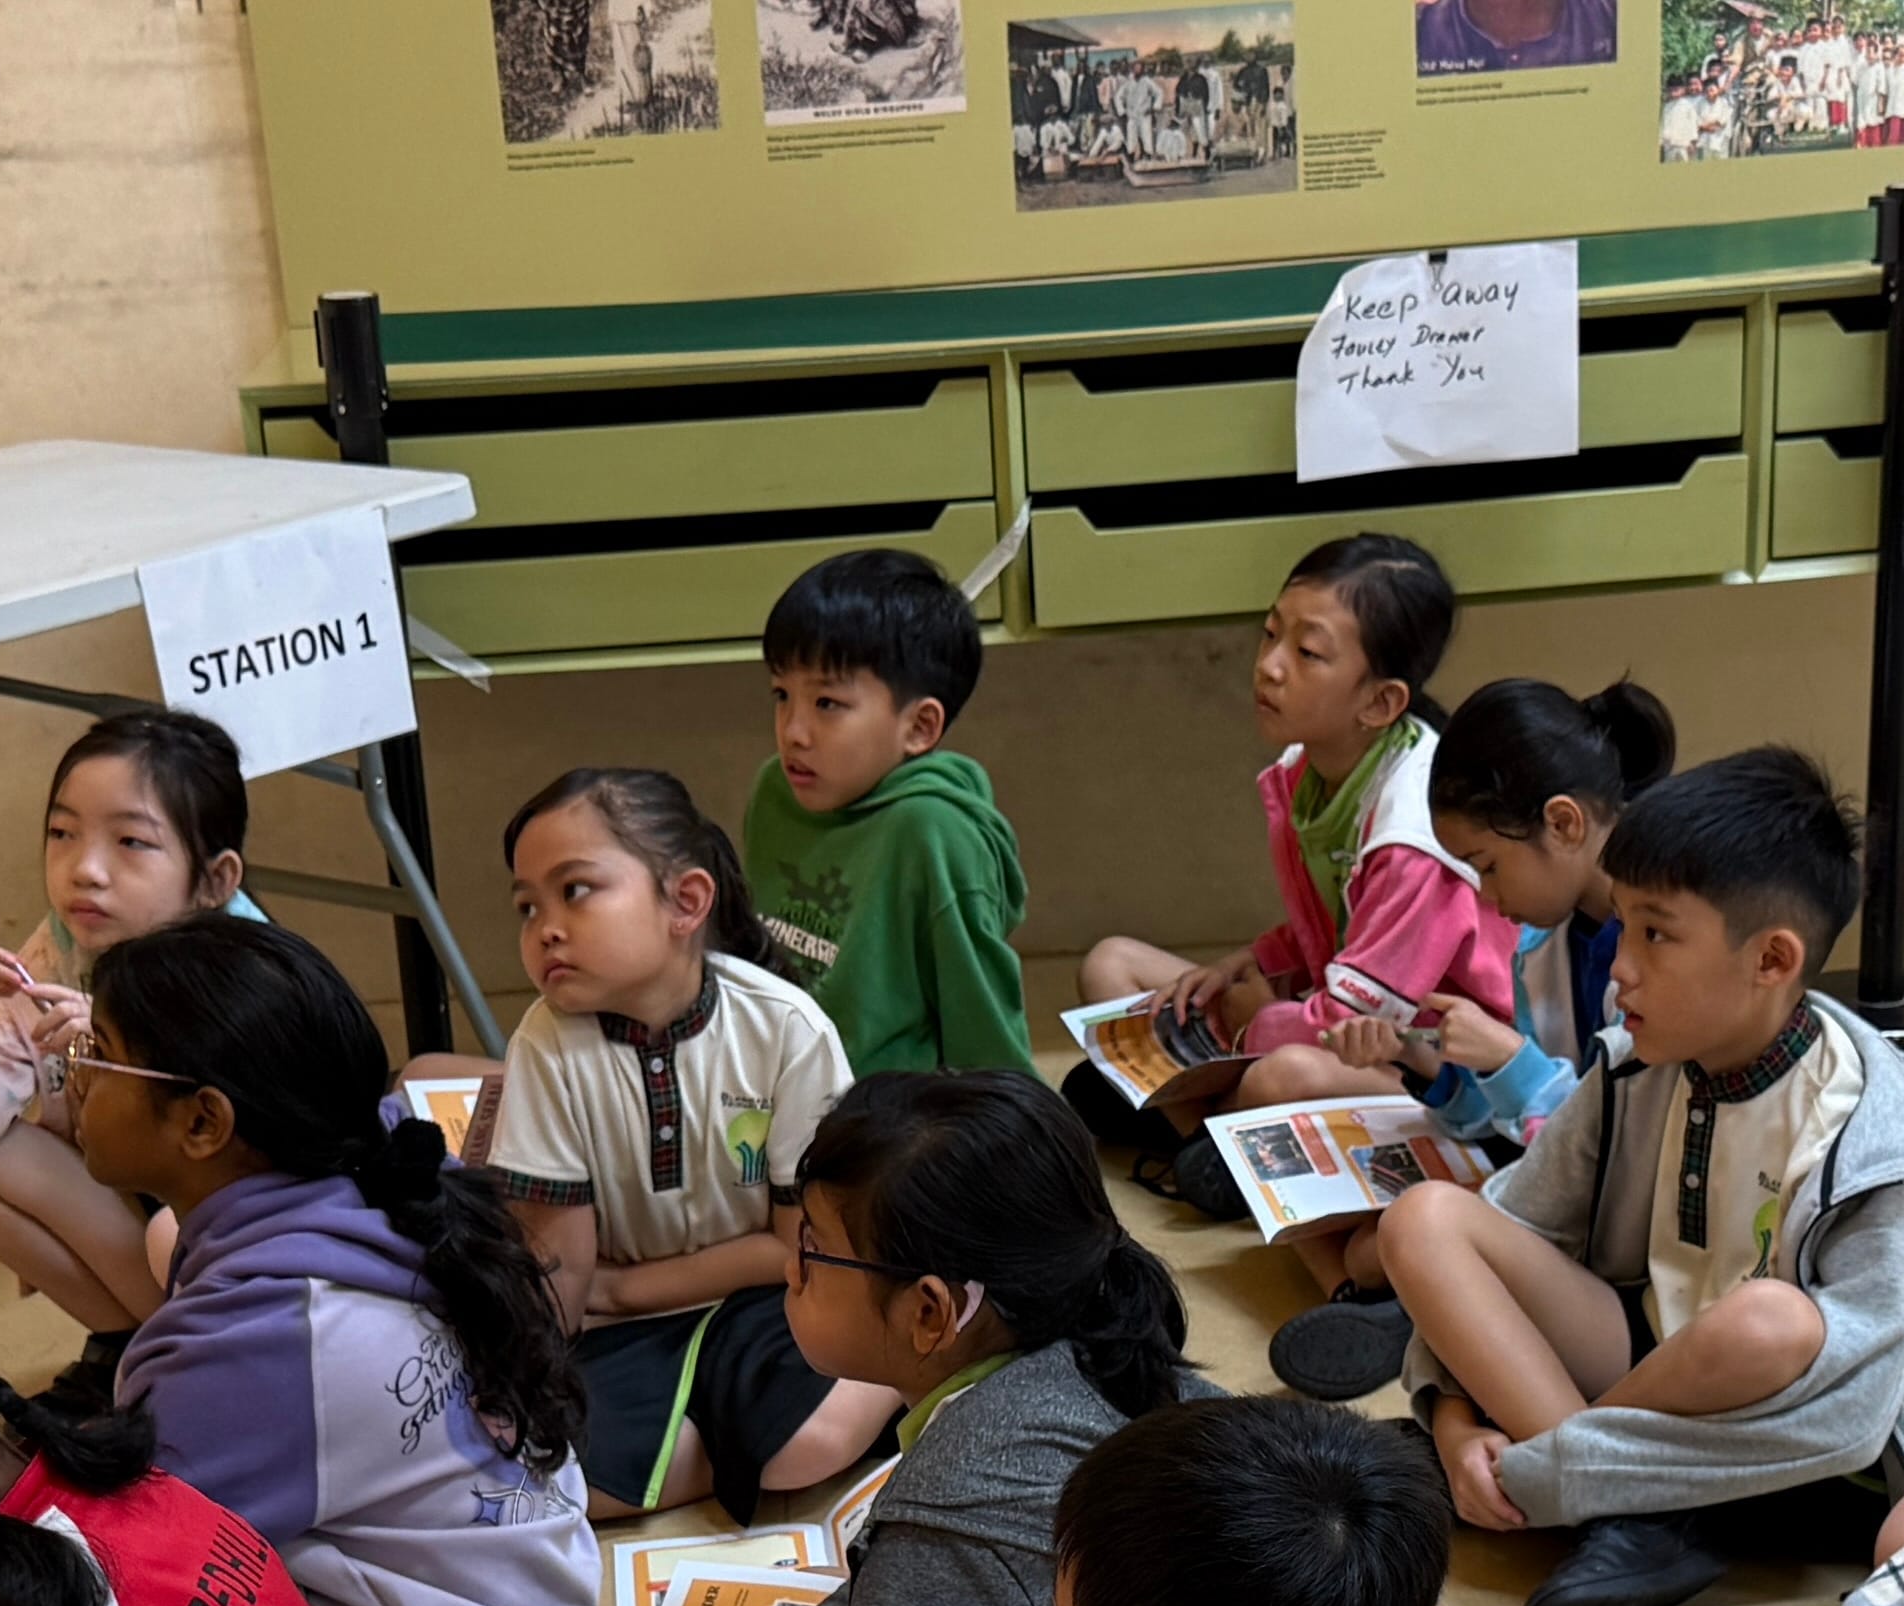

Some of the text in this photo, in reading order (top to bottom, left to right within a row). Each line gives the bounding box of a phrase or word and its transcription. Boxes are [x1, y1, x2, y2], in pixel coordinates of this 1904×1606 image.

[1346, 292, 1419, 324] Keep
[1338, 360, 1415, 395] Thank
[188, 611, 378, 695] STATION 1
